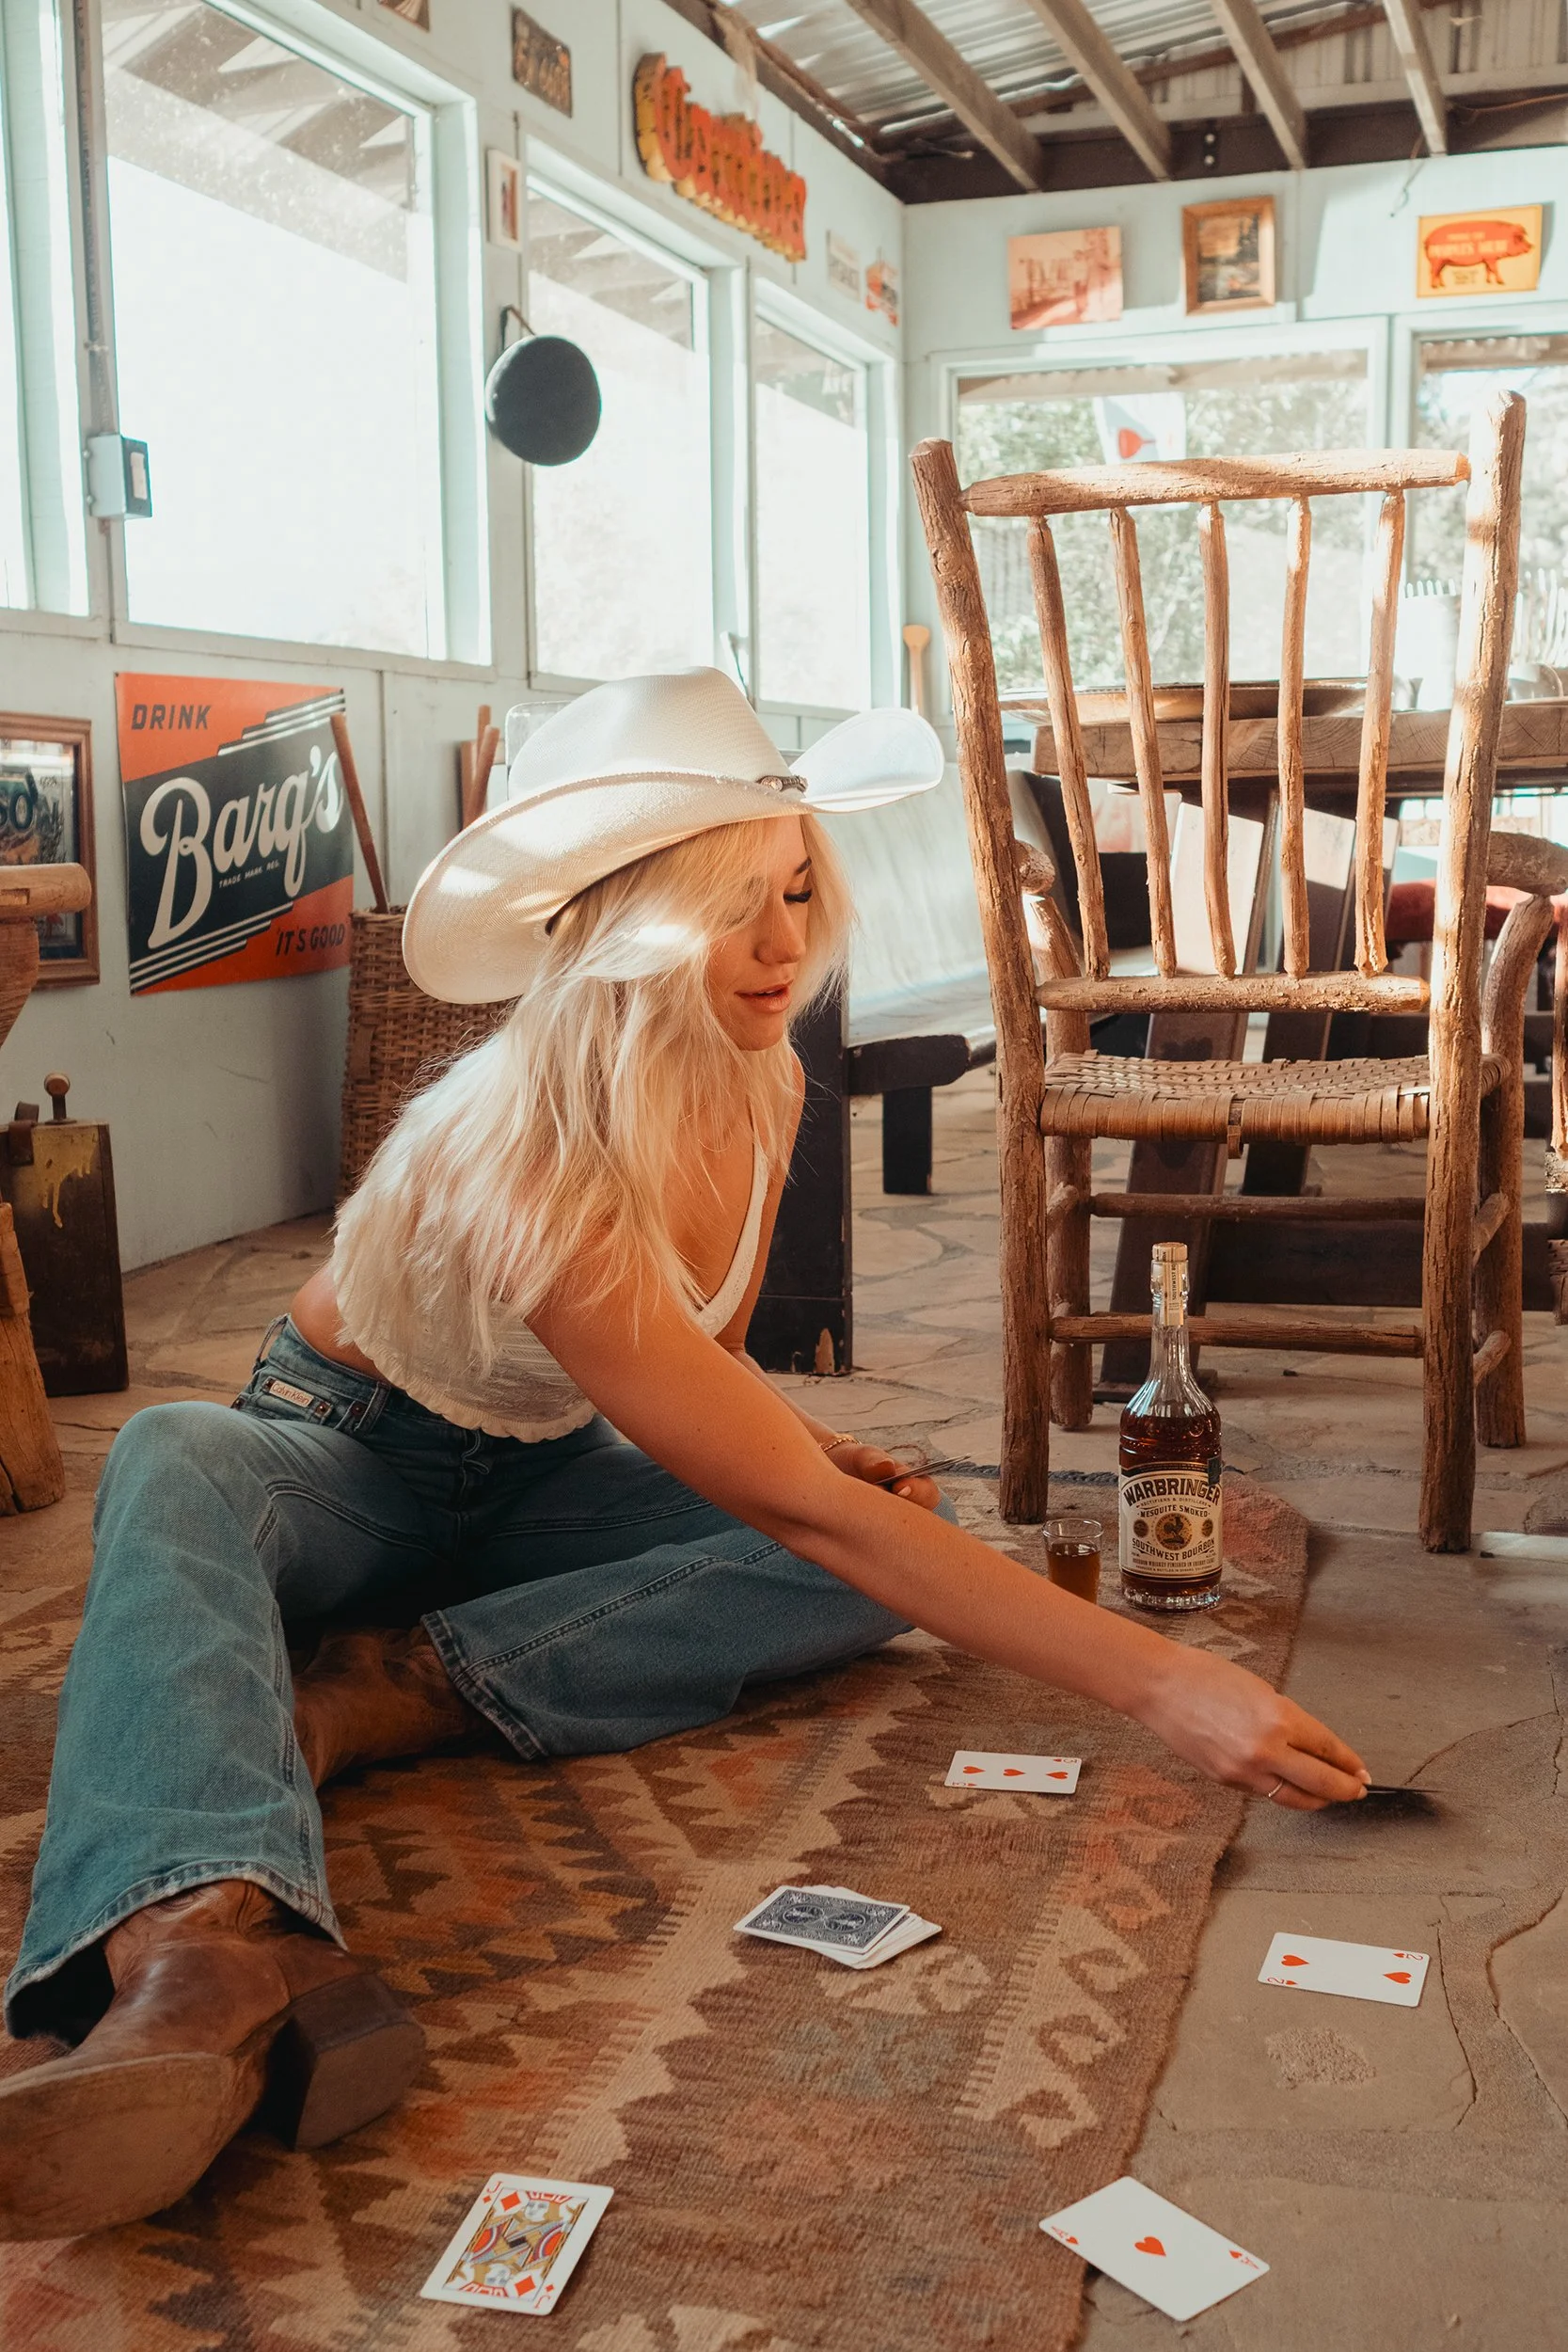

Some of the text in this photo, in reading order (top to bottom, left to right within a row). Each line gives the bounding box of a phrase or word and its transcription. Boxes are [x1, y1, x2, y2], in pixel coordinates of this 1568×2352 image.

[132, 704, 213, 730] DRINK
[140, 745, 343, 949] Barq's
[219, 873, 242, 889] TRADE
[309, 923, 345, 951] GOOD
[1123, 1478, 1221, 1506] WARBRINGER
[1140, 1504, 1209, 1518] MESQUITE SMOKED
[1132, 1537, 1215, 1561] SOUTHWEST BOURBON
[1405, 1951, 1424, 1962] 2
[486, 2181, 503, 2194] J
[534, 2296, 551, 2309] J
